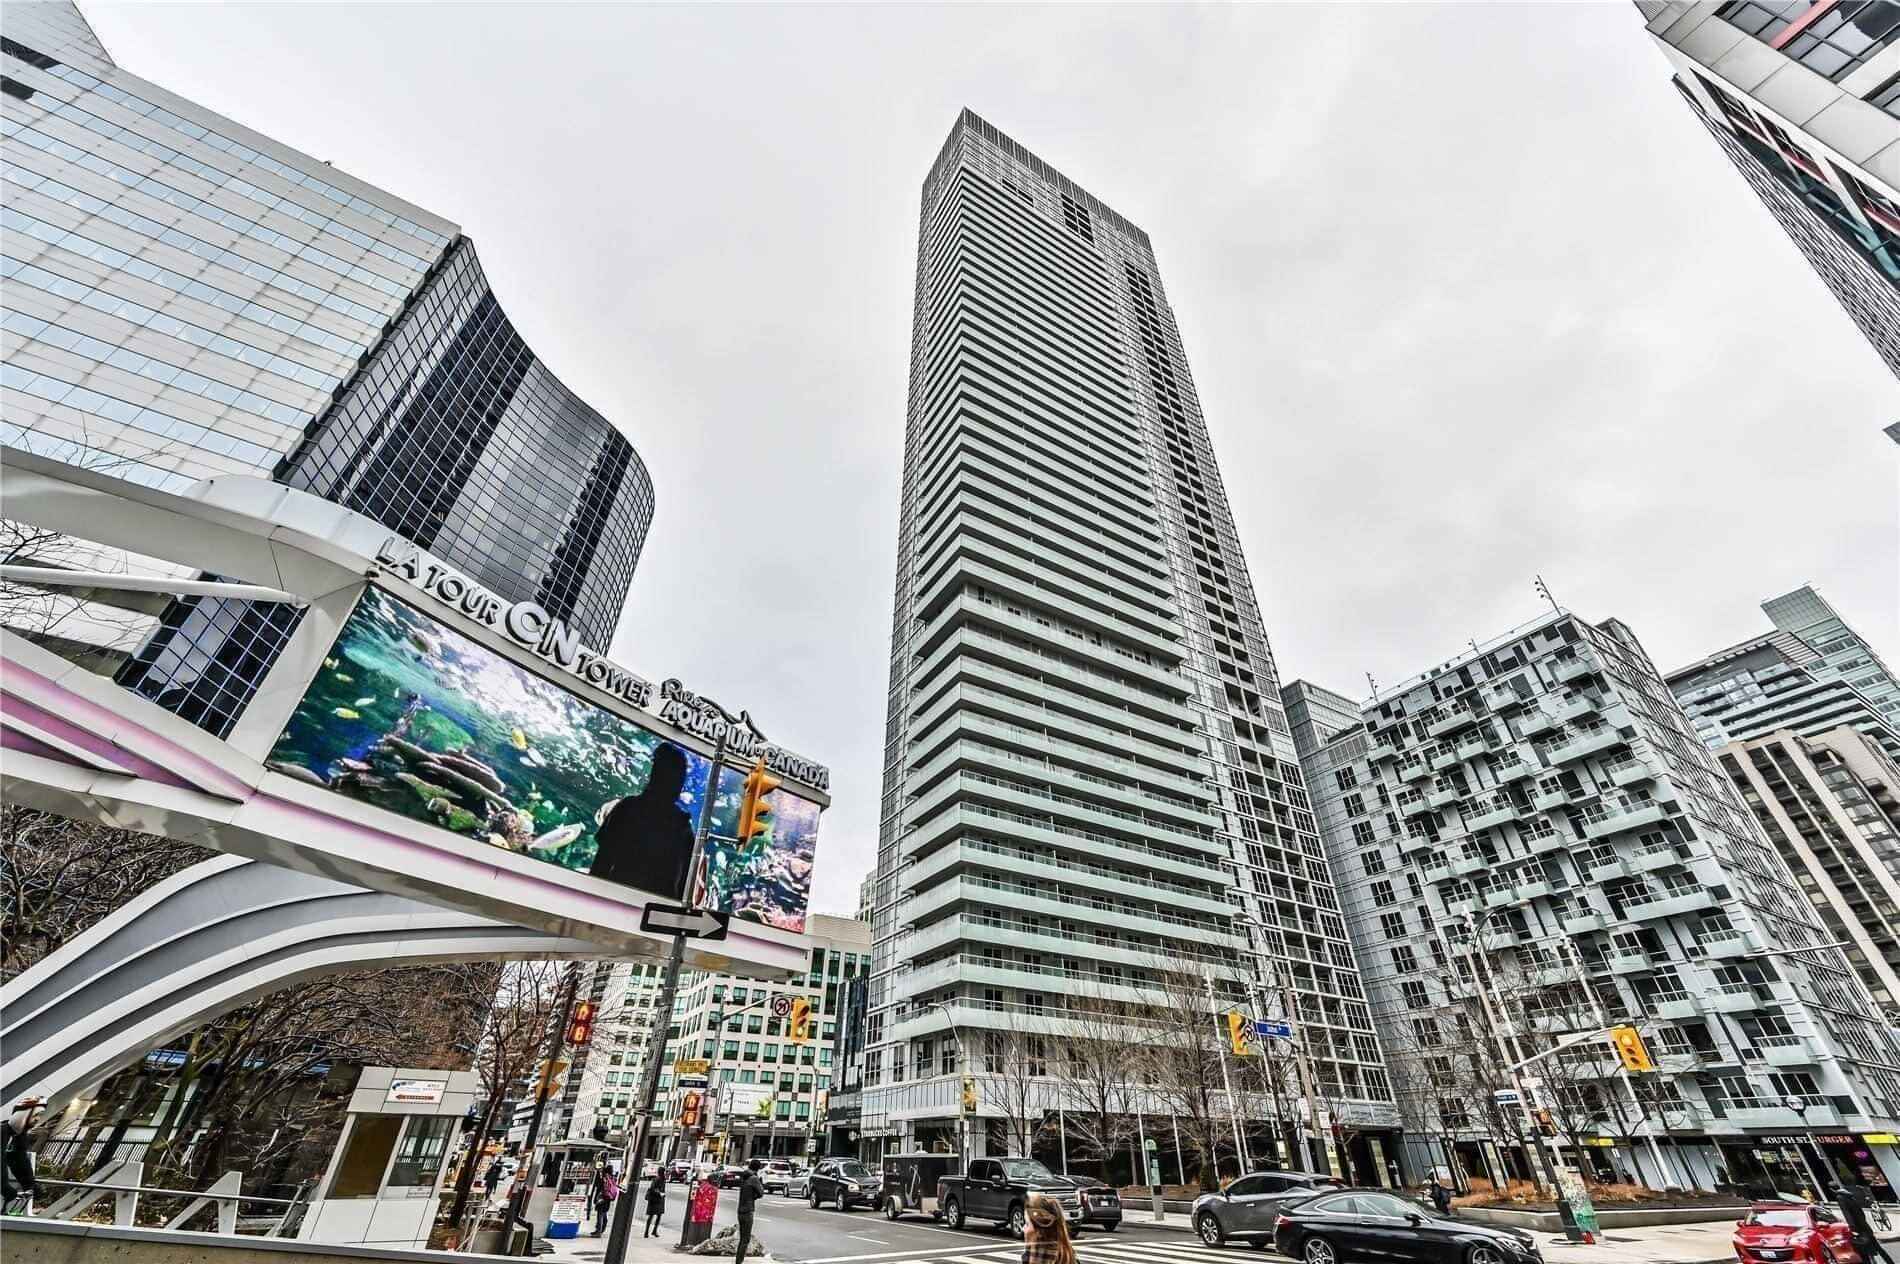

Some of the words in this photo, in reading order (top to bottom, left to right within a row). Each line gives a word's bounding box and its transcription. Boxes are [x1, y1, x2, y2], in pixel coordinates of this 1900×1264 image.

[375, 536, 419, 579] LA
[424, 563, 502, 625] TOUR
[505, 600, 581, 666] CN
[576, 653, 654, 708] TOWER
[766, 745, 831, 790] CANADA
[1761, 1136, 1795, 1144] SOUTH
[1813, 1135, 1854, 1144] URGER
